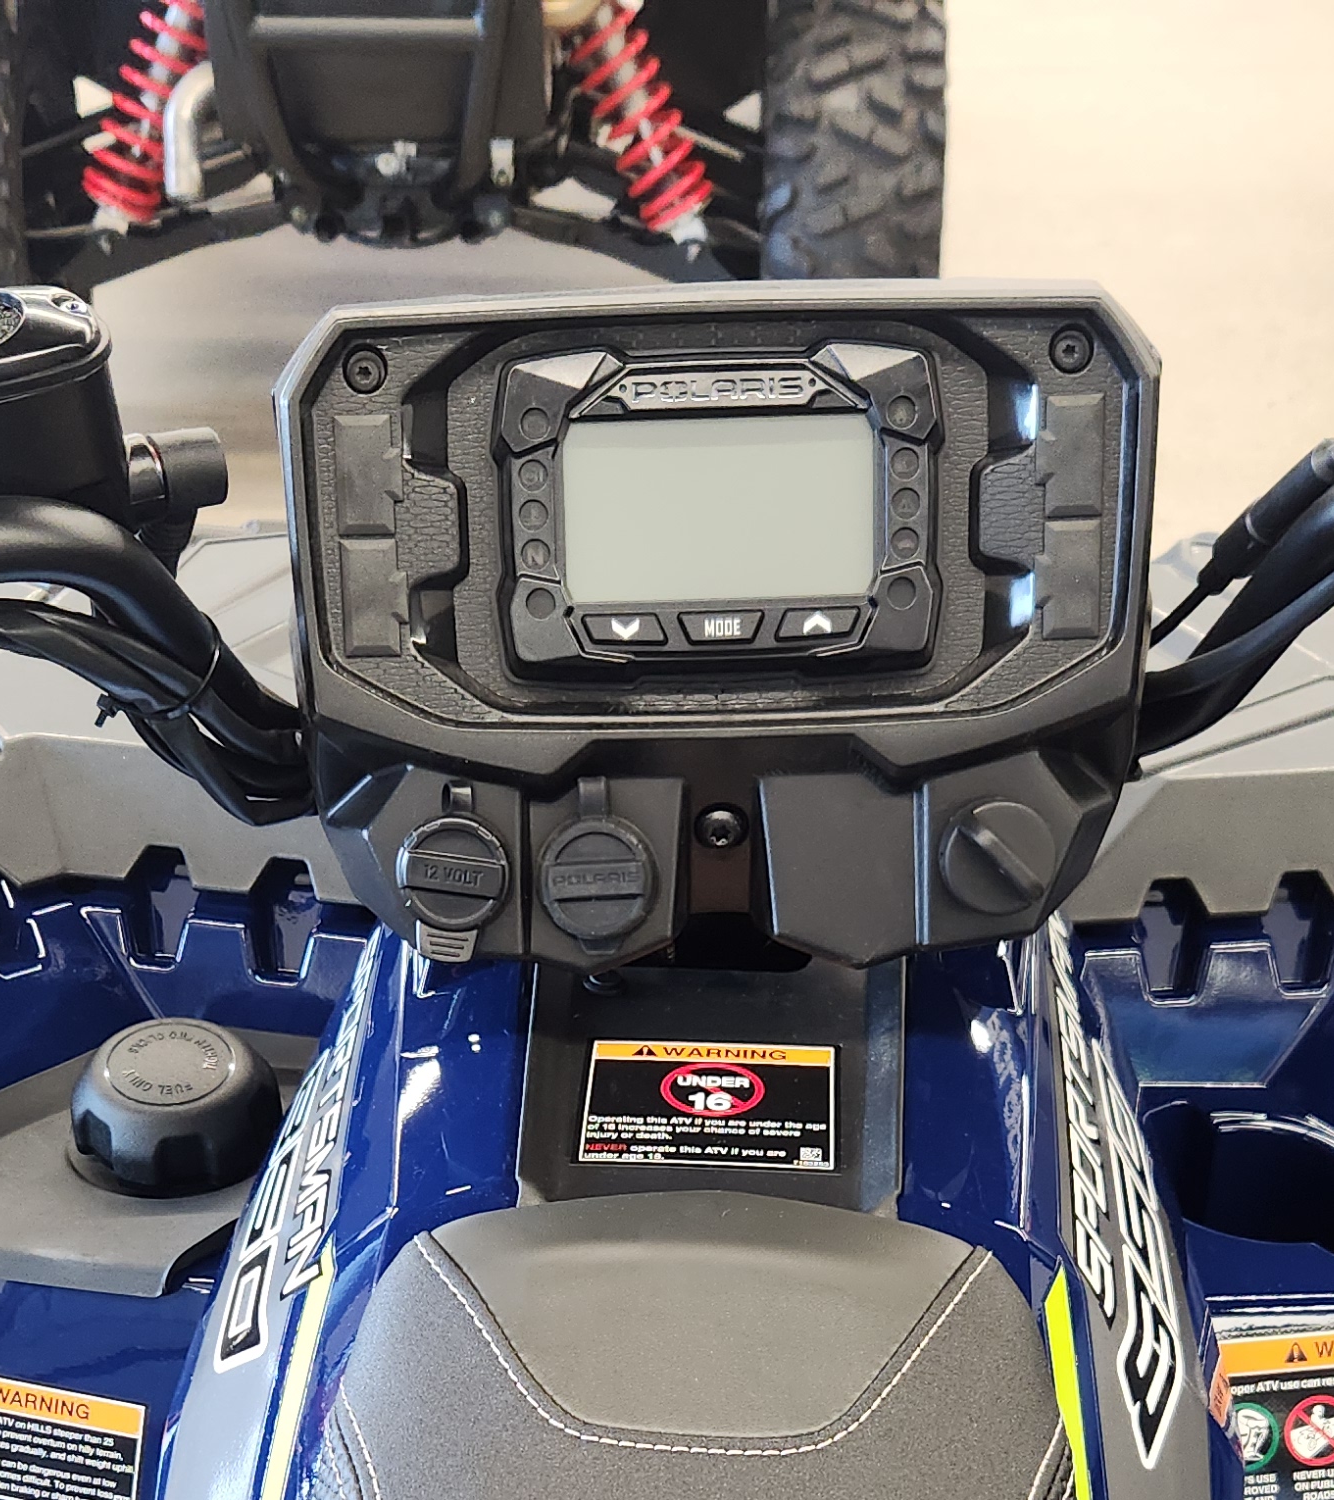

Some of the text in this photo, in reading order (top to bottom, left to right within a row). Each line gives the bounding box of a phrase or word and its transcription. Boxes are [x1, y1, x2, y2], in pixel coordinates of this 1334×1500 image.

[631, 376, 804, 403] POLARIS
[703, 617, 743, 638] MODE
[443, 866, 484, 888] VOLT
[552, 870, 641, 887] POLARIS
[662, 1046, 785, 1060] WARNING
[676, 1075, 750, 1088] UNDER
[687, 1091, 732, 1111] 16
[588, 1114, 644, 1125] Operating
[669, 1117, 692, 1126] ATV
[704, 1119, 725, 1128] you
[749, 1120, 782, 1129] under
[784, 1121, 802, 1129] the
[674, 1126, 701, 1135] your
[585, 1143, 627, 1151] NEVER
[629, 1144, 676, 1155] operate
[704, 1147, 727, 1155] ATV
[741, 1149, 763, 1158] you
[1256, 1379, 1278, 1391] ATV
[1256, 1473, 1276, 1483] USE
[1293, 1468, 1326, 1480] NEVER
[1294, 1481, 1310, 1491] ON
